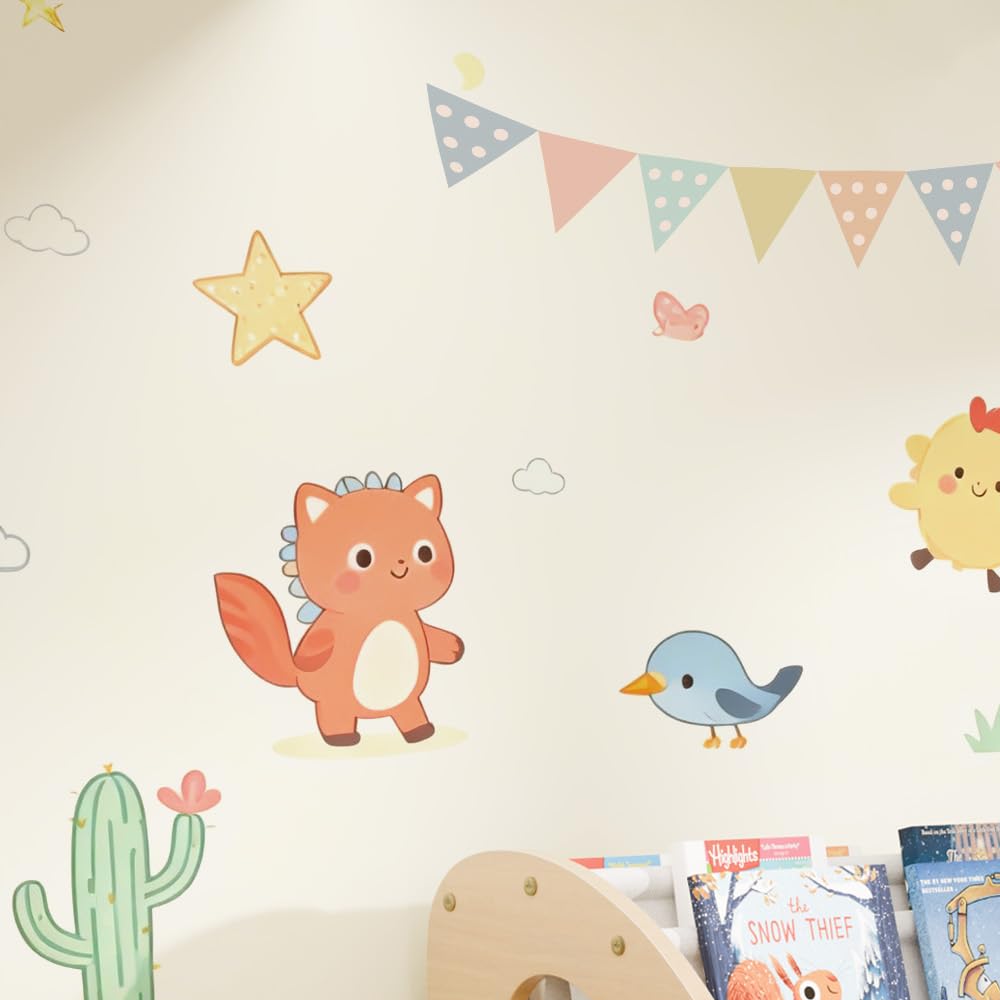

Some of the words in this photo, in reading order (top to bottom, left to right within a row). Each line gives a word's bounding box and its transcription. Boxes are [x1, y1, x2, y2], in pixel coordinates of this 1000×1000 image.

[708, 843, 759, 870] Highlights
[787, 896, 810, 913] the
[747, 918, 796, 945] SNOW
[805, 916, 854, 941] THIEF
